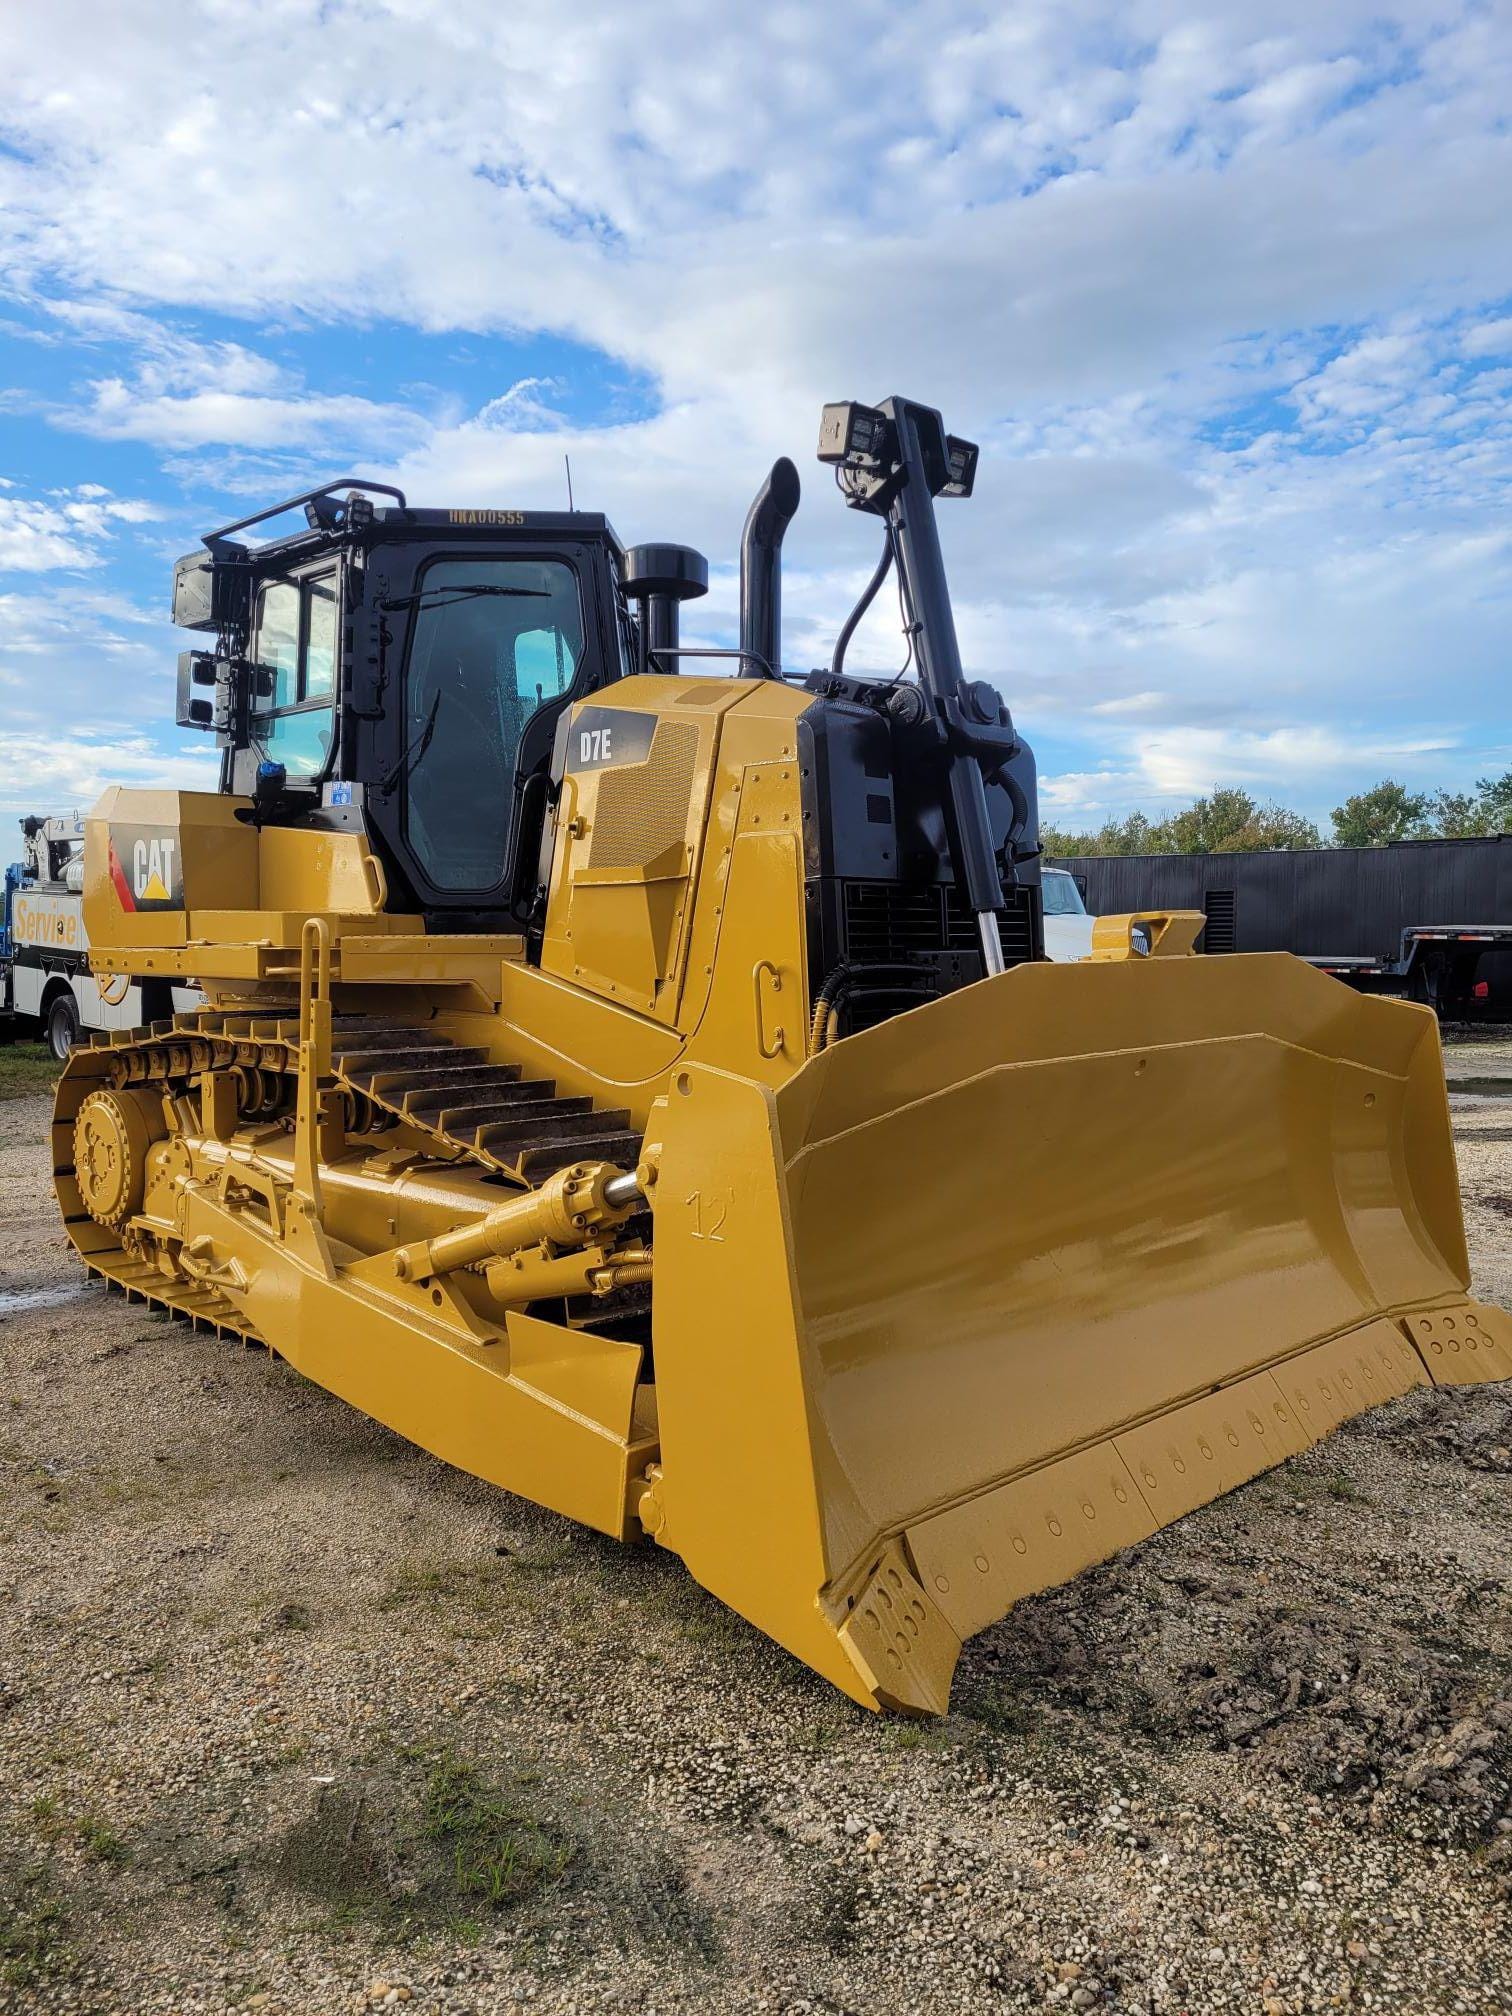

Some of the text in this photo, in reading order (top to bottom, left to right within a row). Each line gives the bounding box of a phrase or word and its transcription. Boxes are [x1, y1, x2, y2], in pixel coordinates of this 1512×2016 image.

[581, 728, 611, 762] D7E
[133, 839, 175, 899] CAT
[15, 899, 76, 944] Service
